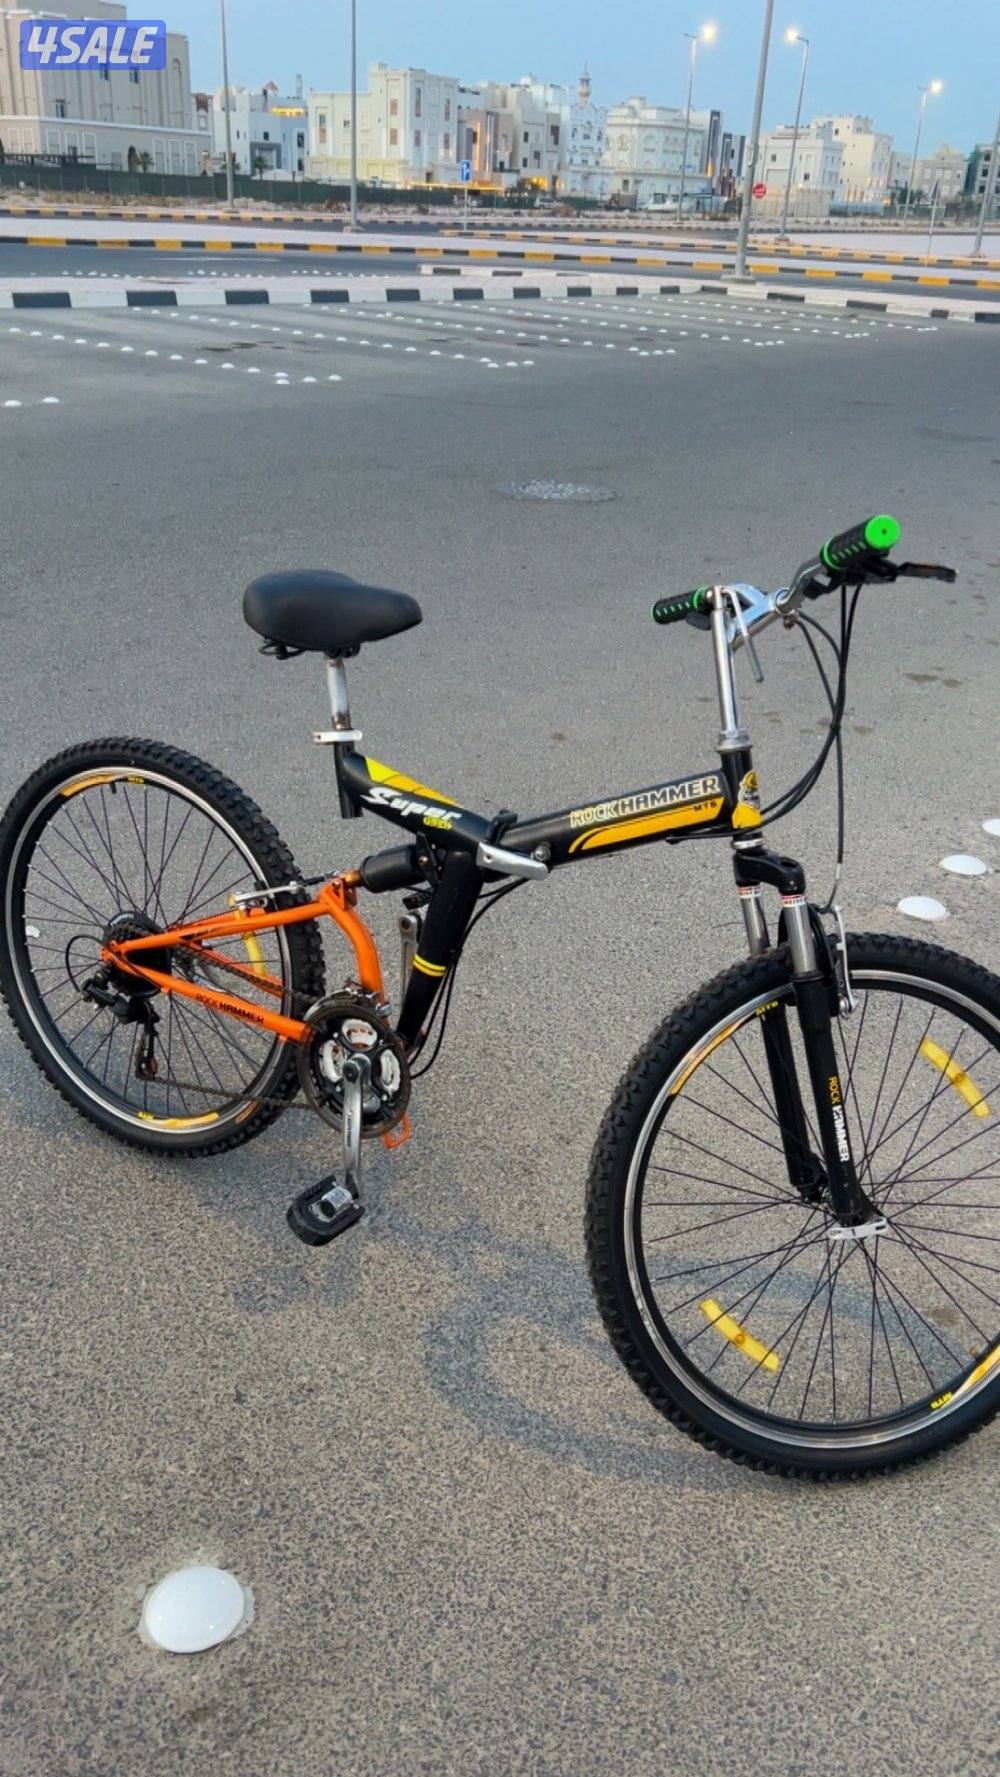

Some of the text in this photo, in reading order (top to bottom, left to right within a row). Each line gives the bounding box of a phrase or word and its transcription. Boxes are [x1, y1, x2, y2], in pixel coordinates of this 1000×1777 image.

[360, 786, 463, 821] Super
[693, 800, 719, 813] MTB
[219, 1004, 265, 1024] HAMMER
[828, 1076, 840, 1104] ROCK
